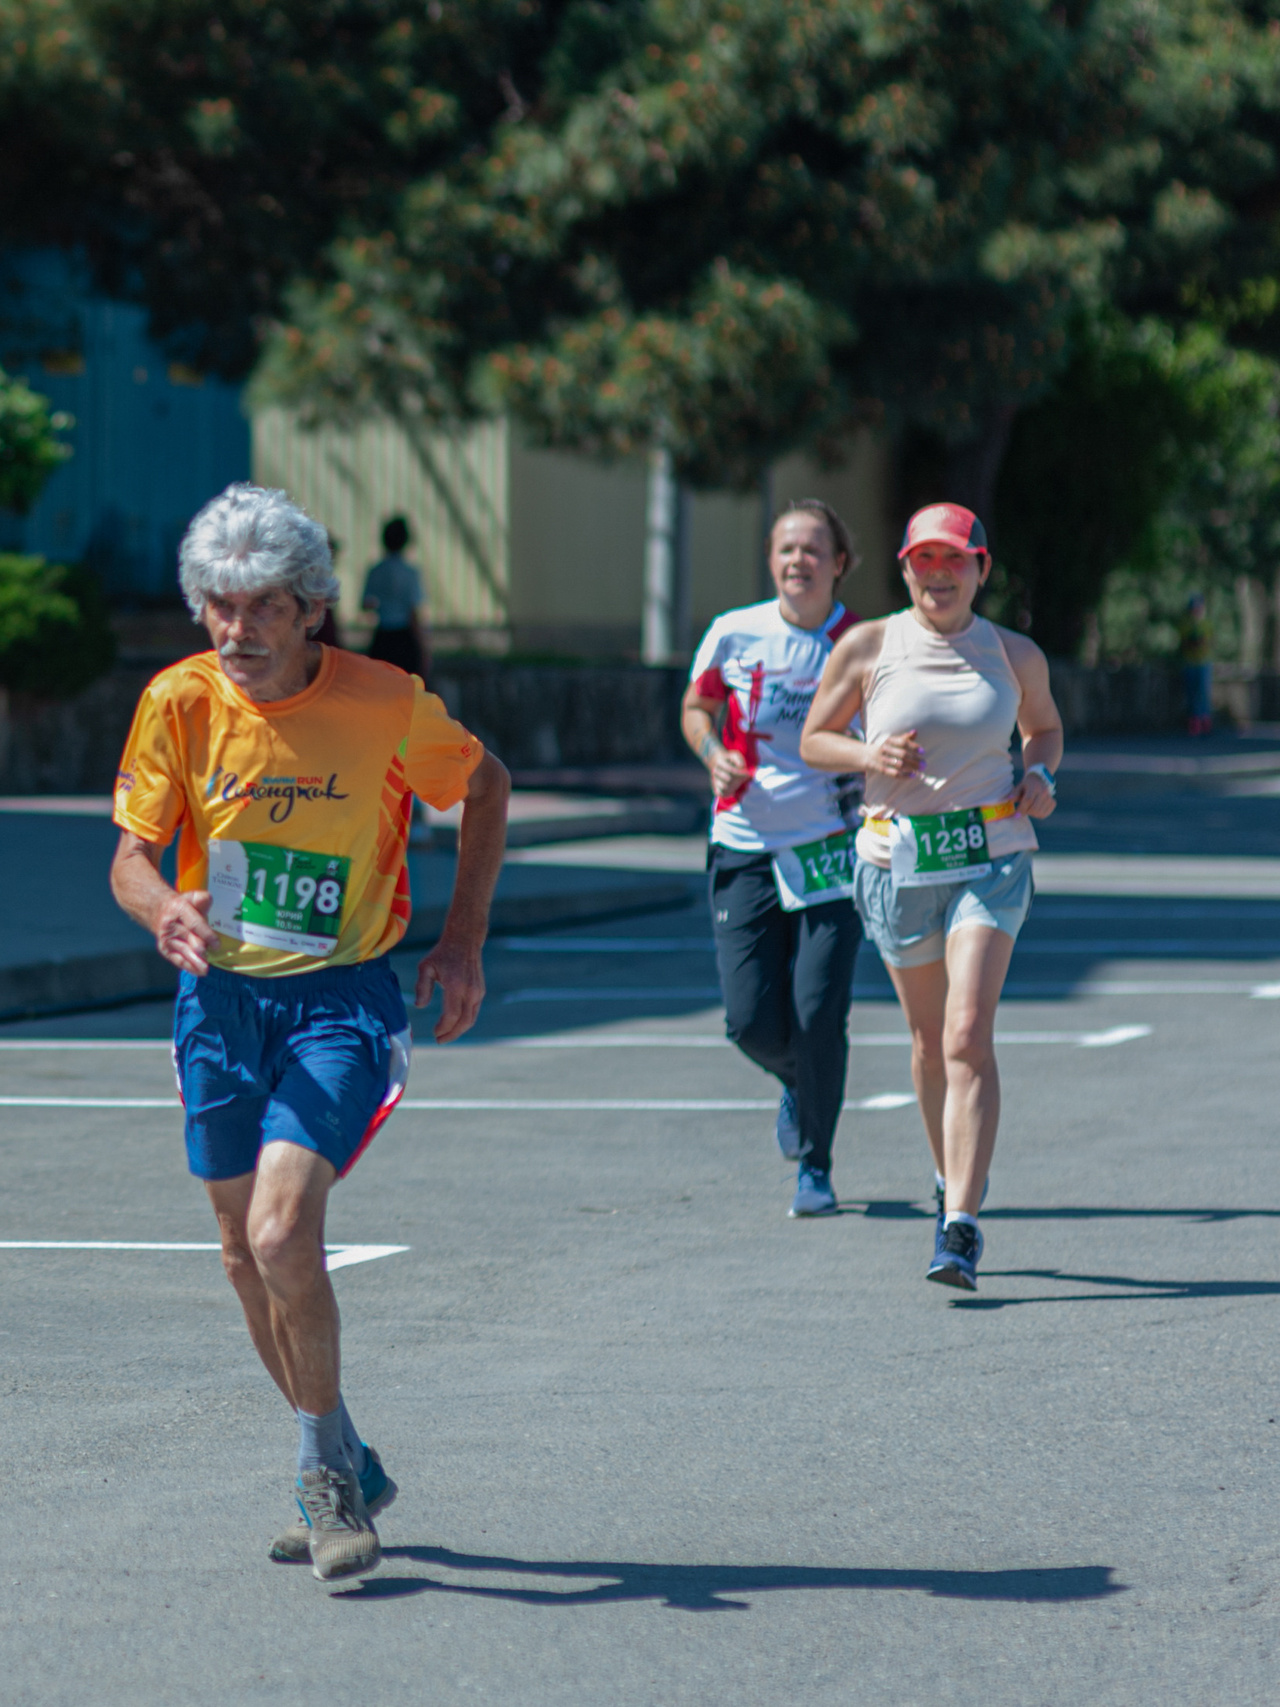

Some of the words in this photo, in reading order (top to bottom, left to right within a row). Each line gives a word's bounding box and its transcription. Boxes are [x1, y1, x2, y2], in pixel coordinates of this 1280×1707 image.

[920, 824, 984, 856] 1238
[252, 868, 340, 914] 1198
[276, 909, 303, 921] ЮРИЙ
